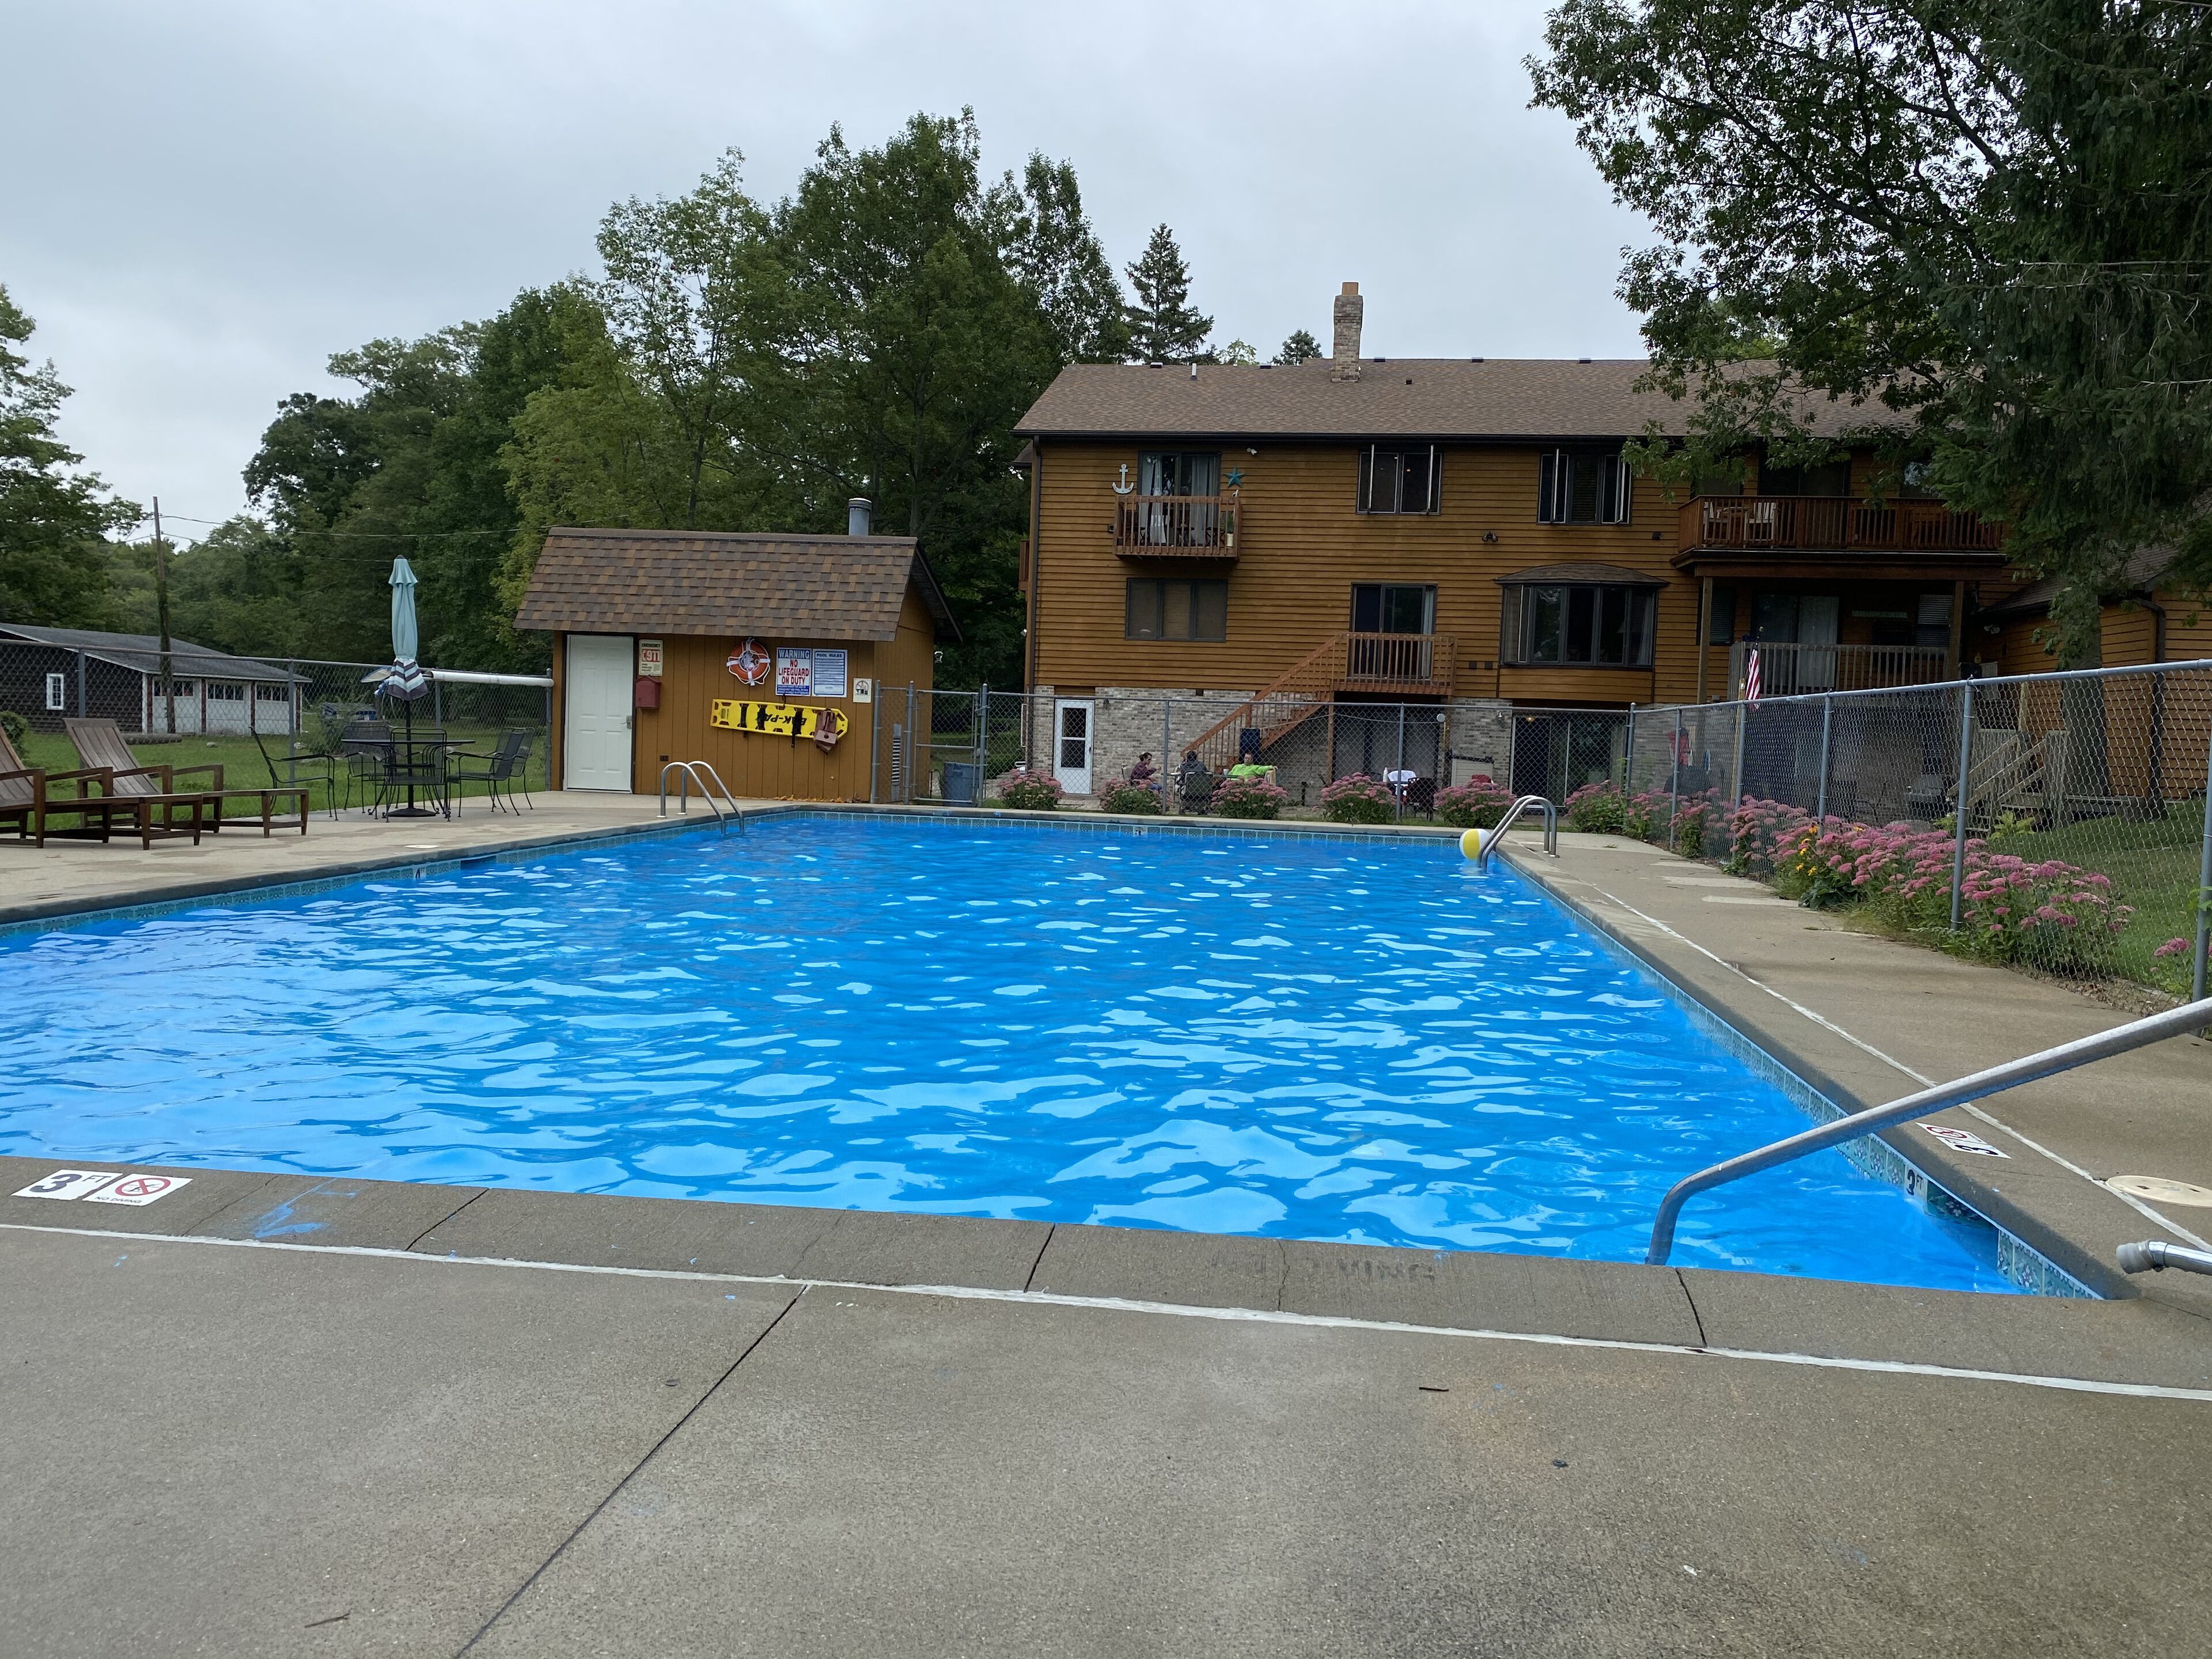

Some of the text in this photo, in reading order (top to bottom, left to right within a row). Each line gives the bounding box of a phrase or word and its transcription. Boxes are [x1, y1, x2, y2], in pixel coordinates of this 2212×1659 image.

[646, 650, 660, 661] 911
[779, 649, 810, 659] WARNING
[790, 659, 798, 668] NO
[778, 668, 809, 677] LIFEGUARD
[782, 676, 805, 685] ON DUTY
[29, 1174, 112, 1193] 3 FT
[1916, 1174, 1923, 1190] FT
